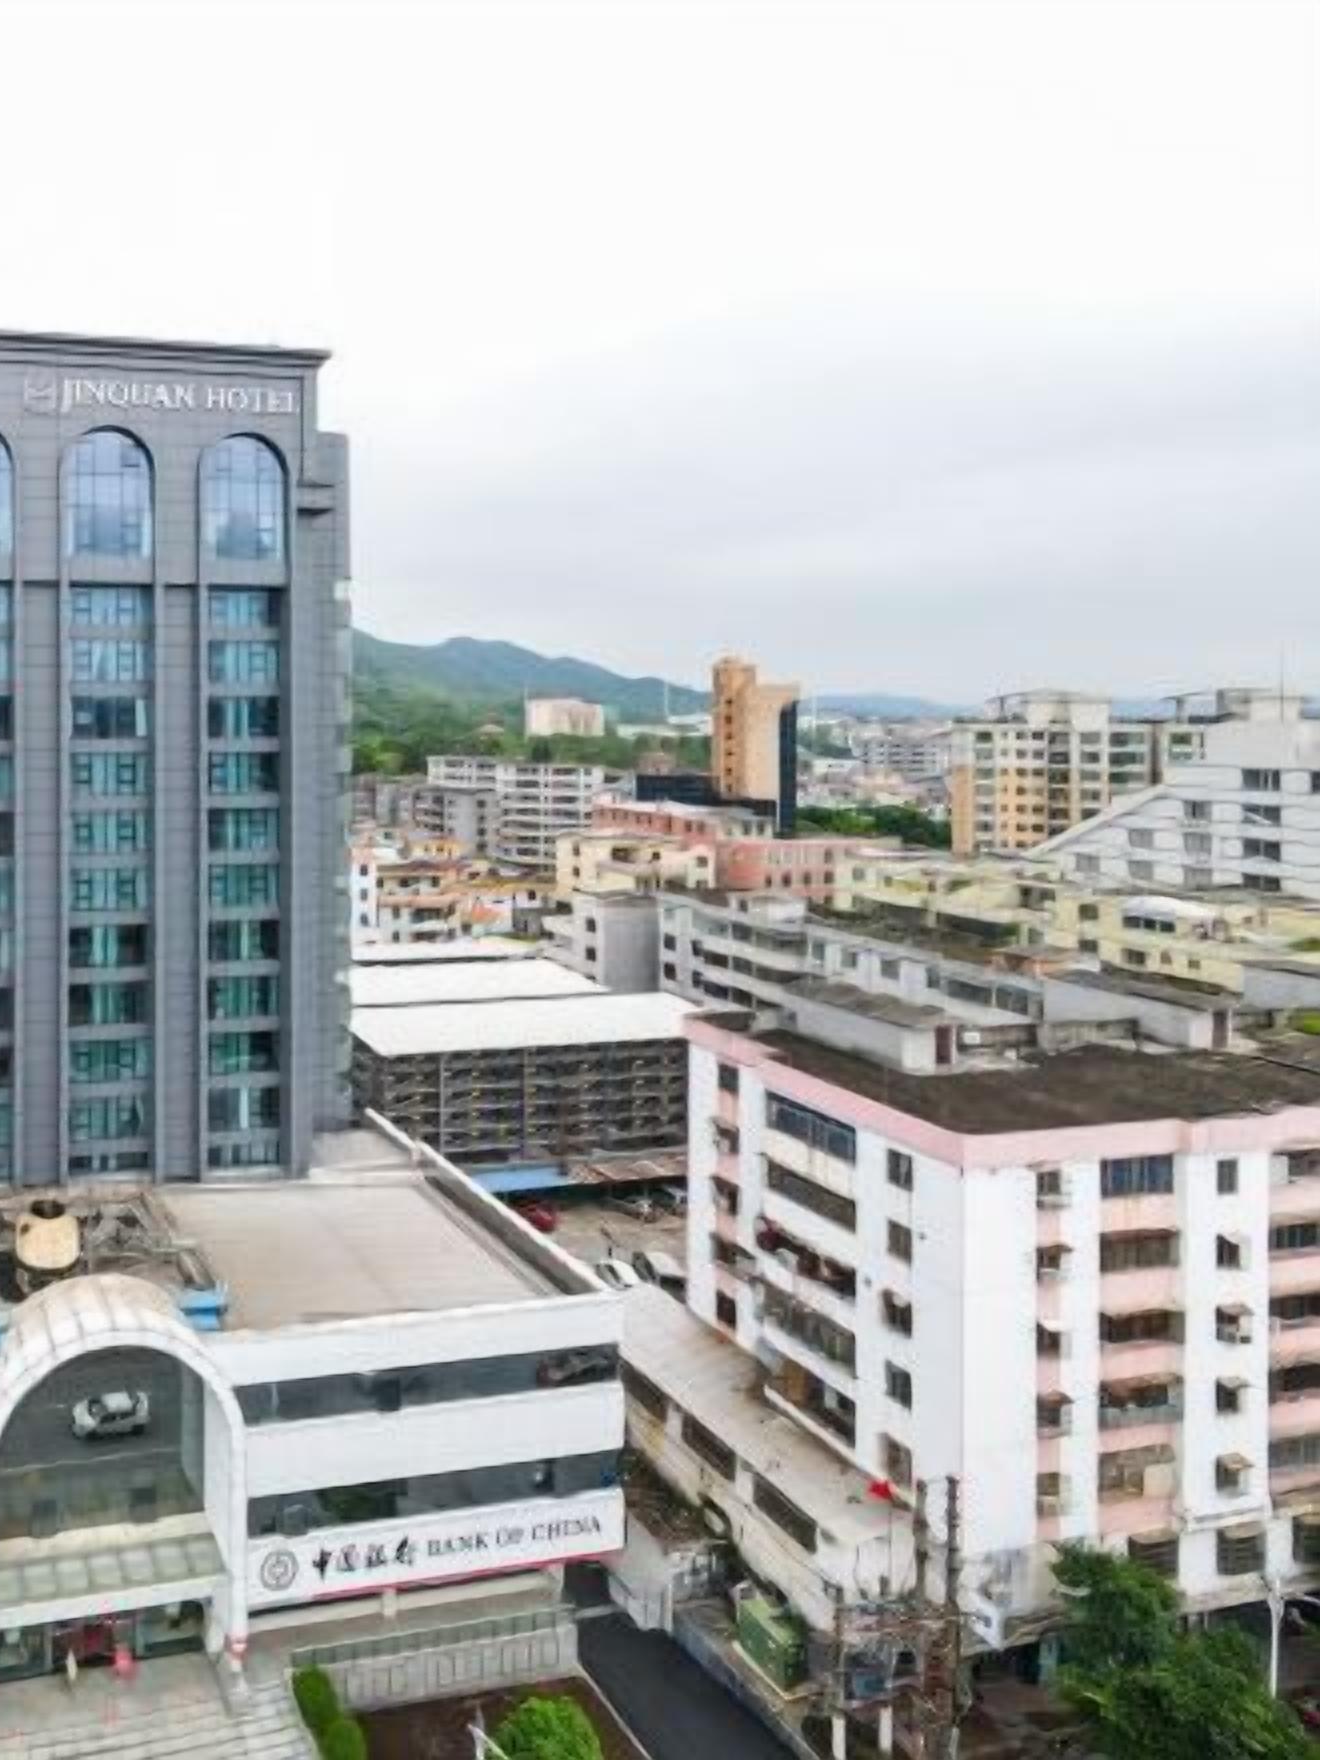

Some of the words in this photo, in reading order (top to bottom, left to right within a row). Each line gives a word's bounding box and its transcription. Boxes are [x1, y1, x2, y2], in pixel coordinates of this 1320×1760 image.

[61, 379, 195, 413] JINQUAN
[208, 387, 299, 413] HOTEL
[428, 1532, 489, 1556] BANK
[496, 1526, 524, 1546] OF
[532, 1514, 601, 1542] CHINA
